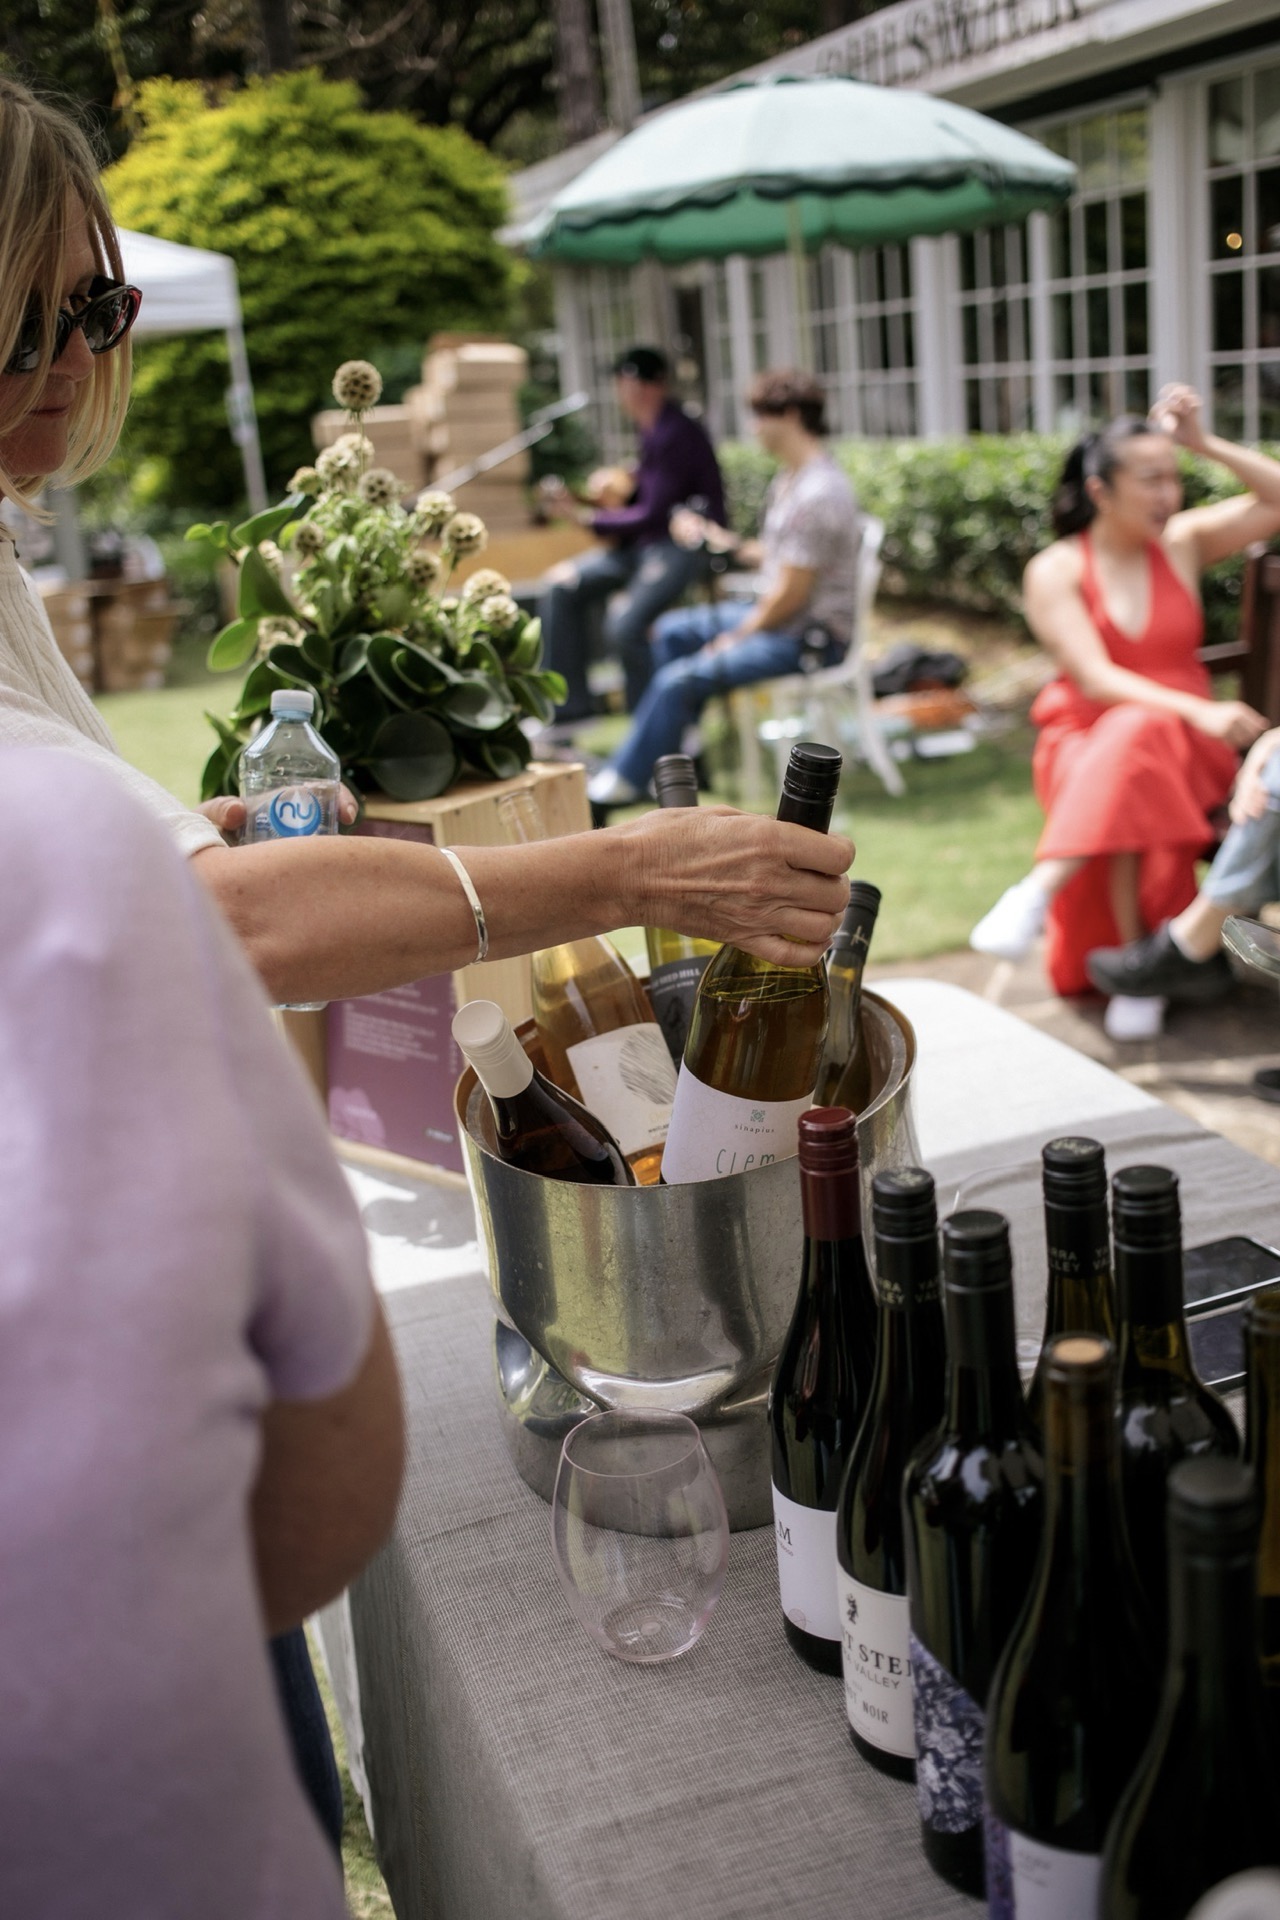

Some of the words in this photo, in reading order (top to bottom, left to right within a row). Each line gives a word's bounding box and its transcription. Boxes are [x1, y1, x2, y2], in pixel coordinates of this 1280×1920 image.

[279, 802, 313, 820] nu
[734, 1123, 775, 1135] sinapius
[855, 1660, 900, 1689] VALLEY
[862, 1700, 889, 1725] NOIR
